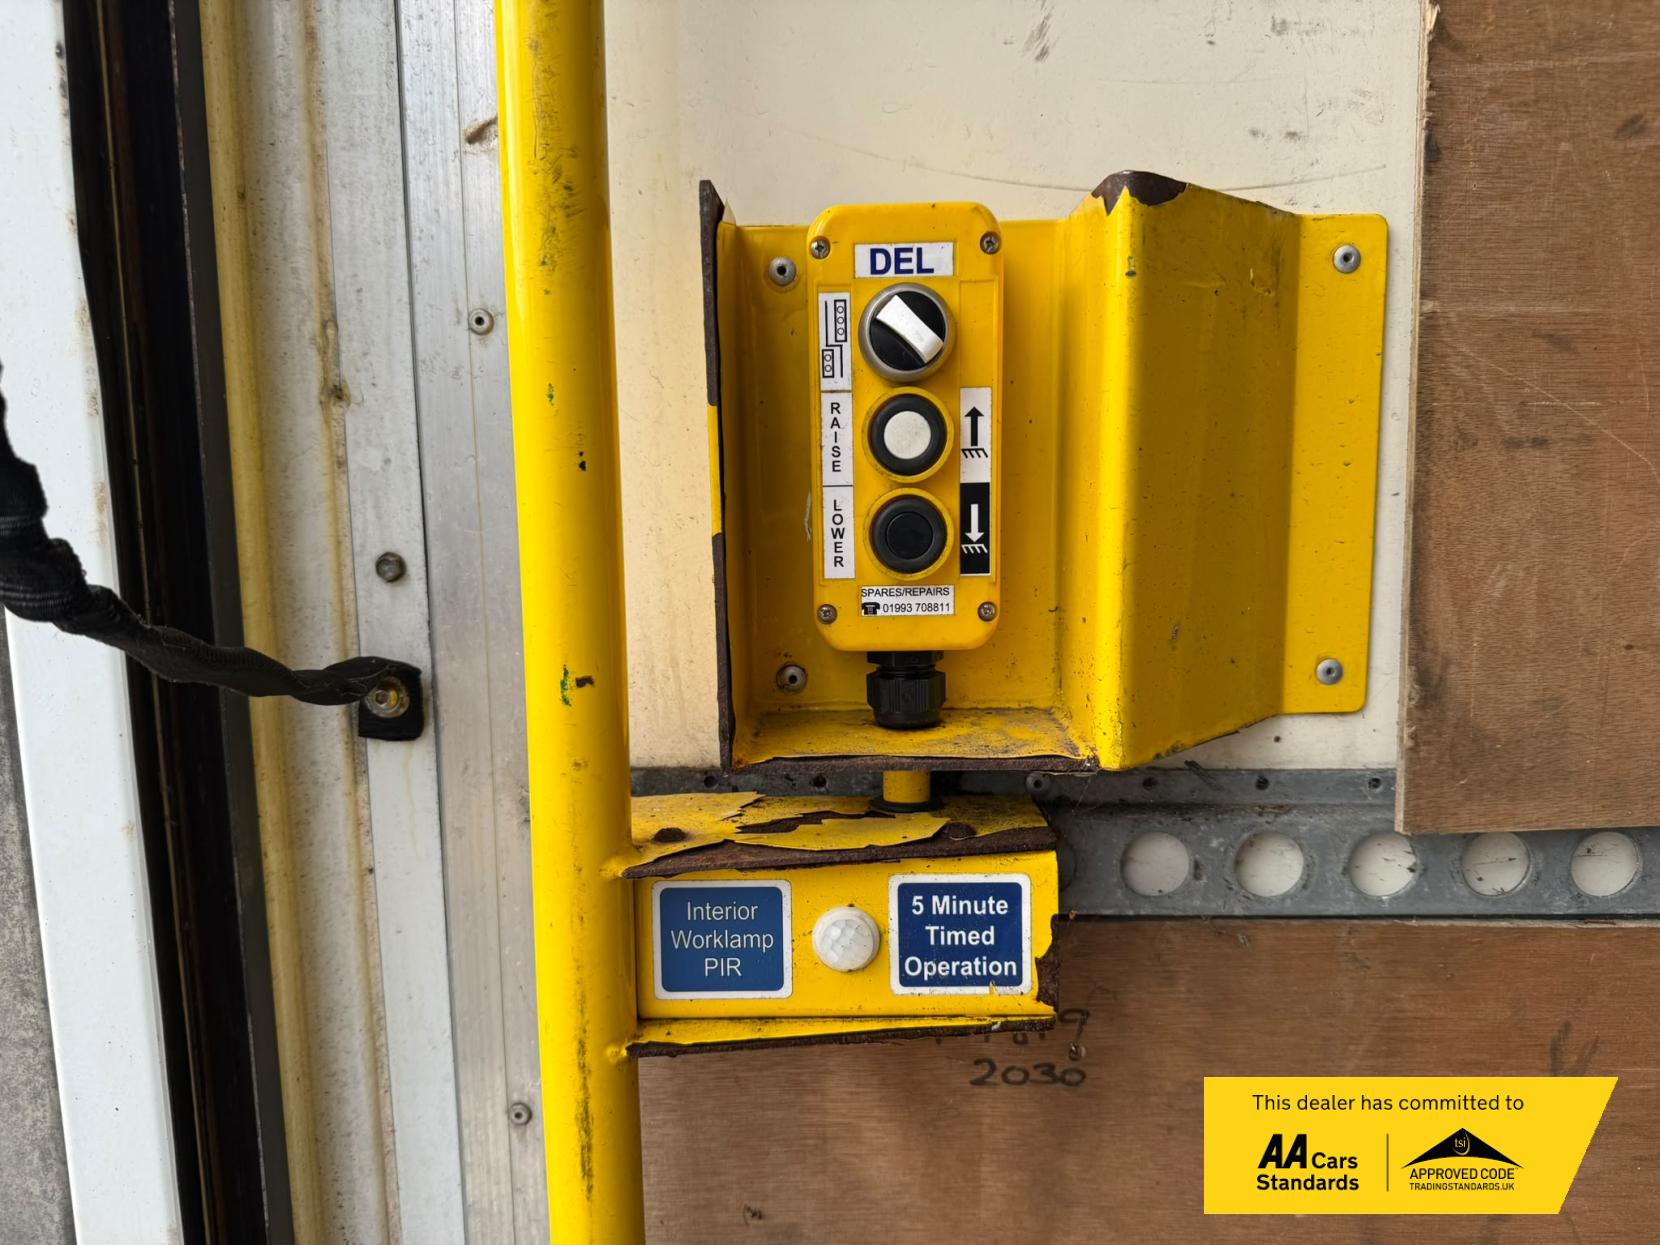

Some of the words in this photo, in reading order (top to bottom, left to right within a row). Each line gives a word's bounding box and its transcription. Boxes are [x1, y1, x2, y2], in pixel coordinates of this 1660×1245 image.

[869, 247, 935, 275] DEL
[829, 402, 842, 473] RAISE
[831, 499, 846, 568] LOWER
[861, 586, 950, 597] SPARES/REPAIRS
[882, 603, 913, 613] 01993
[915, 602, 950, 612] 708811
[686, 900, 759, 921] Interior
[911, 895, 924, 916] 5
[931, 893, 1009, 916] Minute
[670, 929, 774, 952] Worklamp
[924, 925, 995, 946] Timed
[704, 957, 742, 978] PIR
[904, 956, 1017, 980] Operation
[969, 1057, 1087, 1087] 2030
